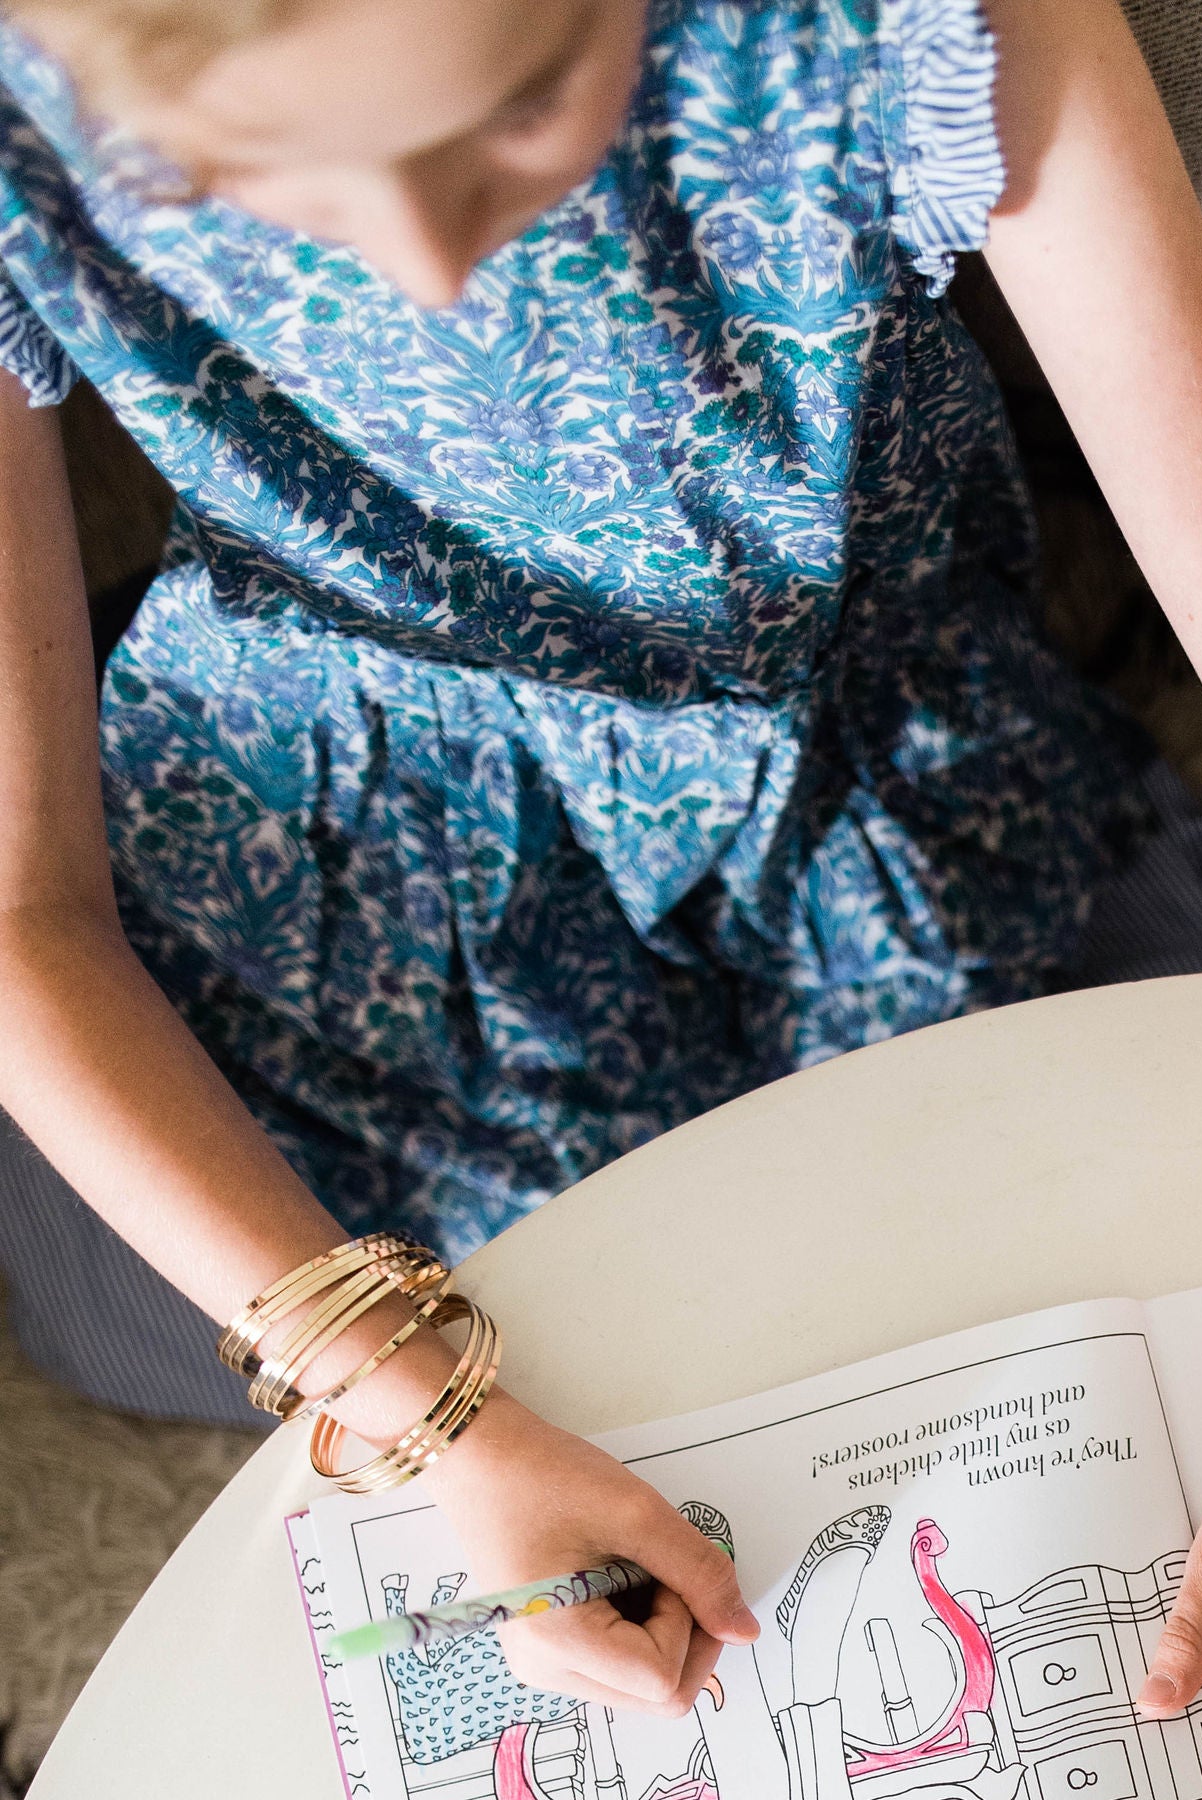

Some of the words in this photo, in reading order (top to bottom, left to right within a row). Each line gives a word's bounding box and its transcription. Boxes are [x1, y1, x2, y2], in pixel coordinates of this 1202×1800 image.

[1042, 1384, 1086, 1414] and
[916, 1395, 1033, 1441] handsome
[1045, 1417, 1071, 1438] as
[949, 1434, 1000, 1465] little
[1006, 1422, 1039, 1448] my
[811, 1427, 908, 1479] roosters!
[967, 1450, 1044, 1487] known
[1051, 1436, 1138, 1469] They're
[848, 1450, 942, 1491] chickens
